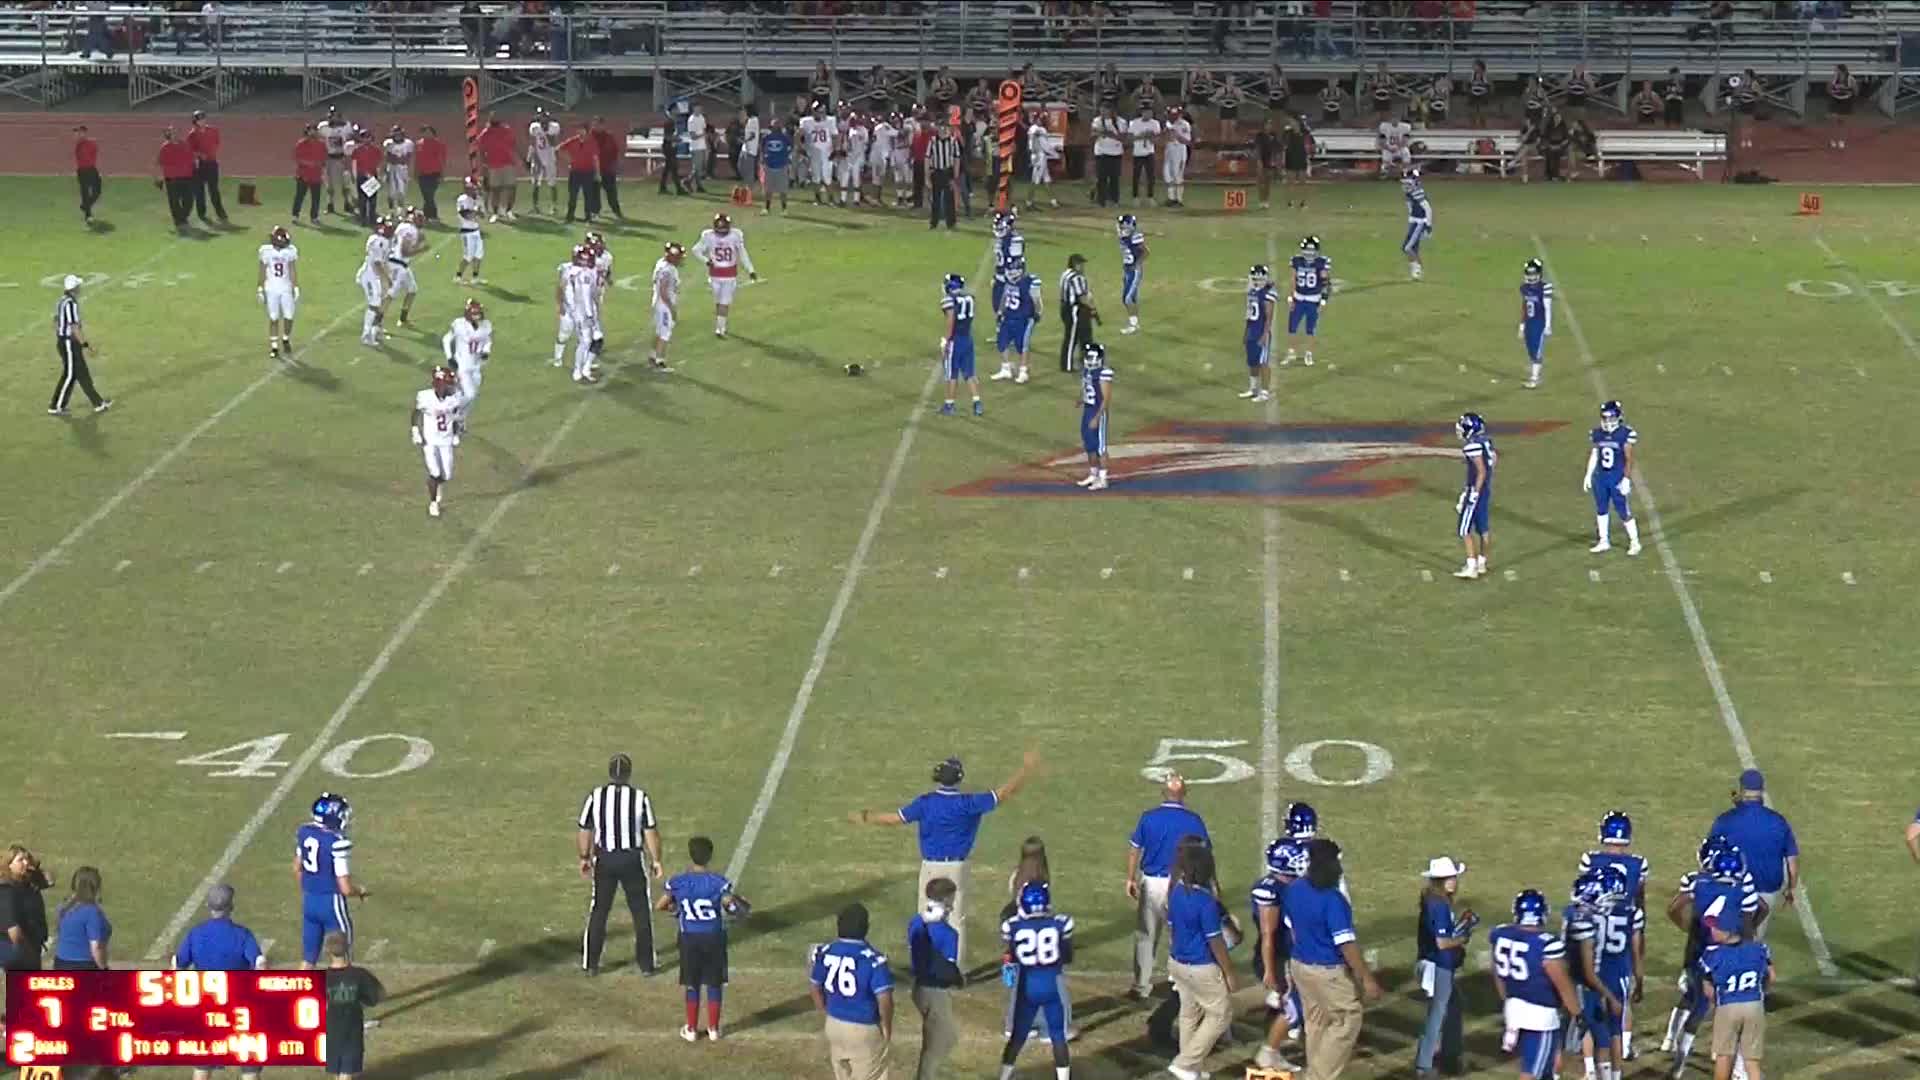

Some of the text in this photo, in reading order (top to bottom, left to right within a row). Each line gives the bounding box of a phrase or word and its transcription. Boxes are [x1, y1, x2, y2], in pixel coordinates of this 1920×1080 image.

[1227, 191, 1244, 207] 50
[1802, 195, 1819, 210] 40
[714, 247, 732, 262] 58
[274, 262, 284, 278] 9
[437, 414, 448, 432] 2
[1601, 447, 1615, 469] 9
[303, 836, 320, 873] 3
[680, 898, 717, 921] 16
[1014, 927, 1061, 967] 28
[1494, 937, 1530, 982] 55
[823, 954, 857, 997] 76
